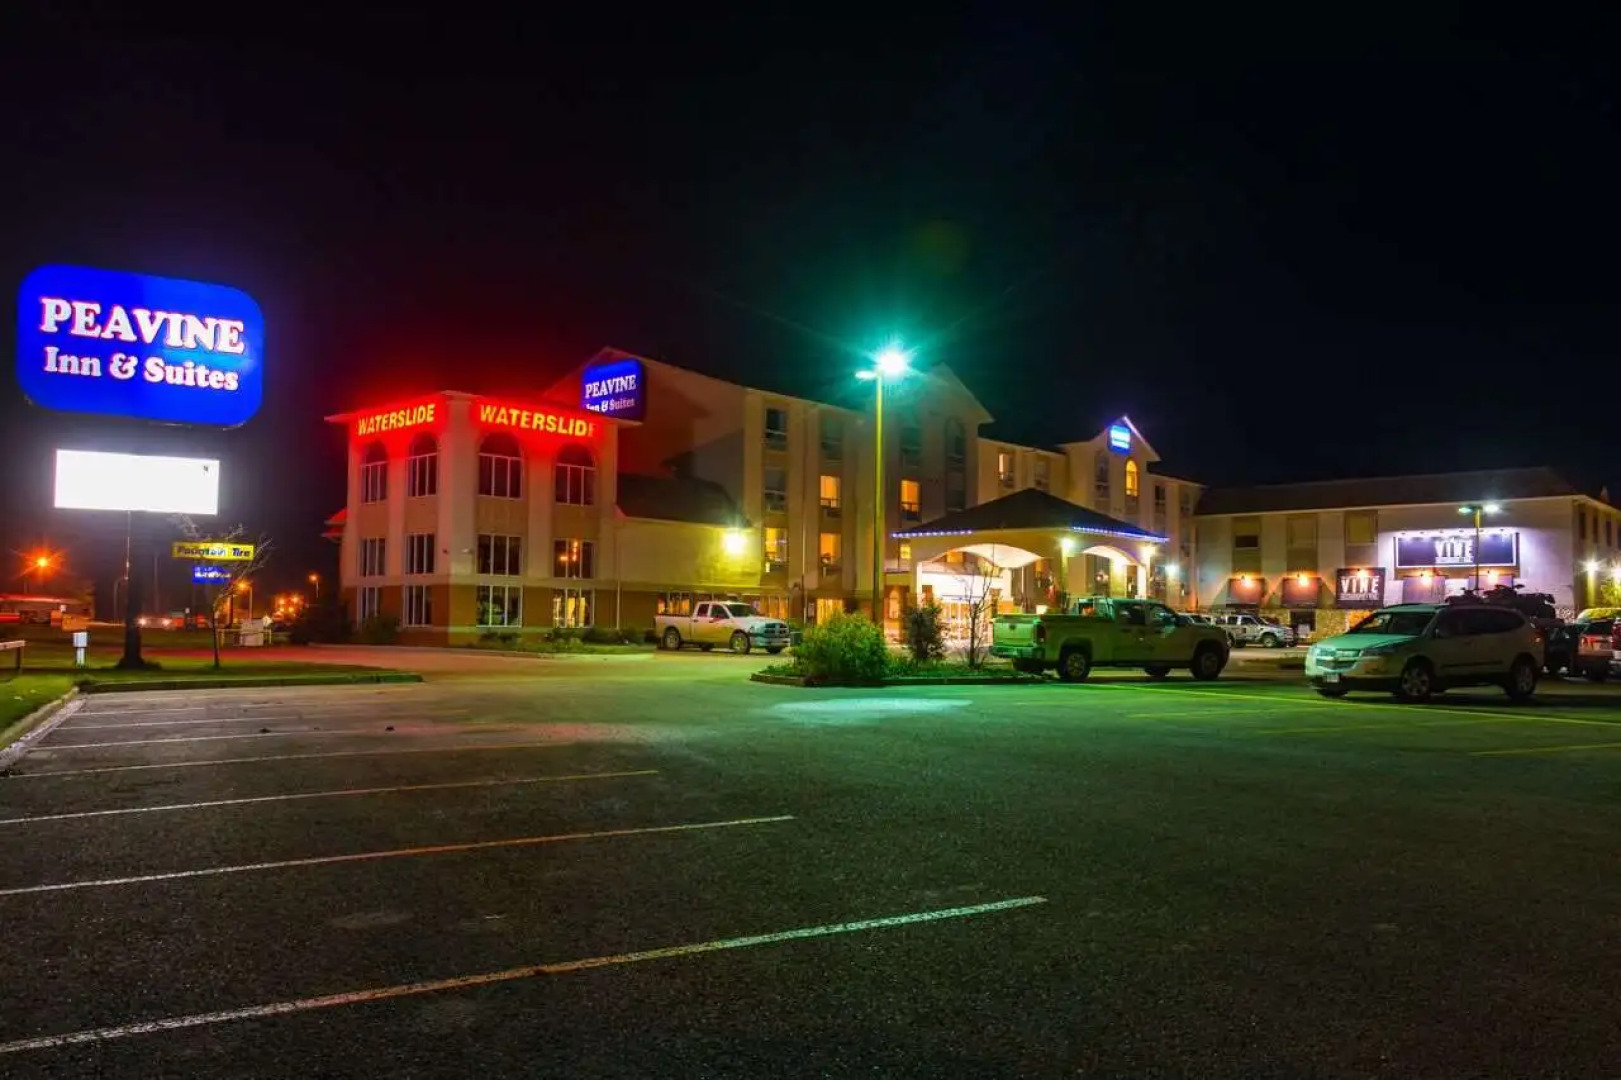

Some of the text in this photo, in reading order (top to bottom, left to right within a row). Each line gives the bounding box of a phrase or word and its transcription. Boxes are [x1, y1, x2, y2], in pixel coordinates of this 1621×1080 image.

[40, 298, 245, 354] PEAVINE
[43, 347, 239, 391] Inn & Suites
[585, 374, 637, 399] PEAVINE
[609, 397, 636, 411] Suites
[358, 403, 436, 436] WATERSLIDE
[232, 547, 250, 557] Tire
